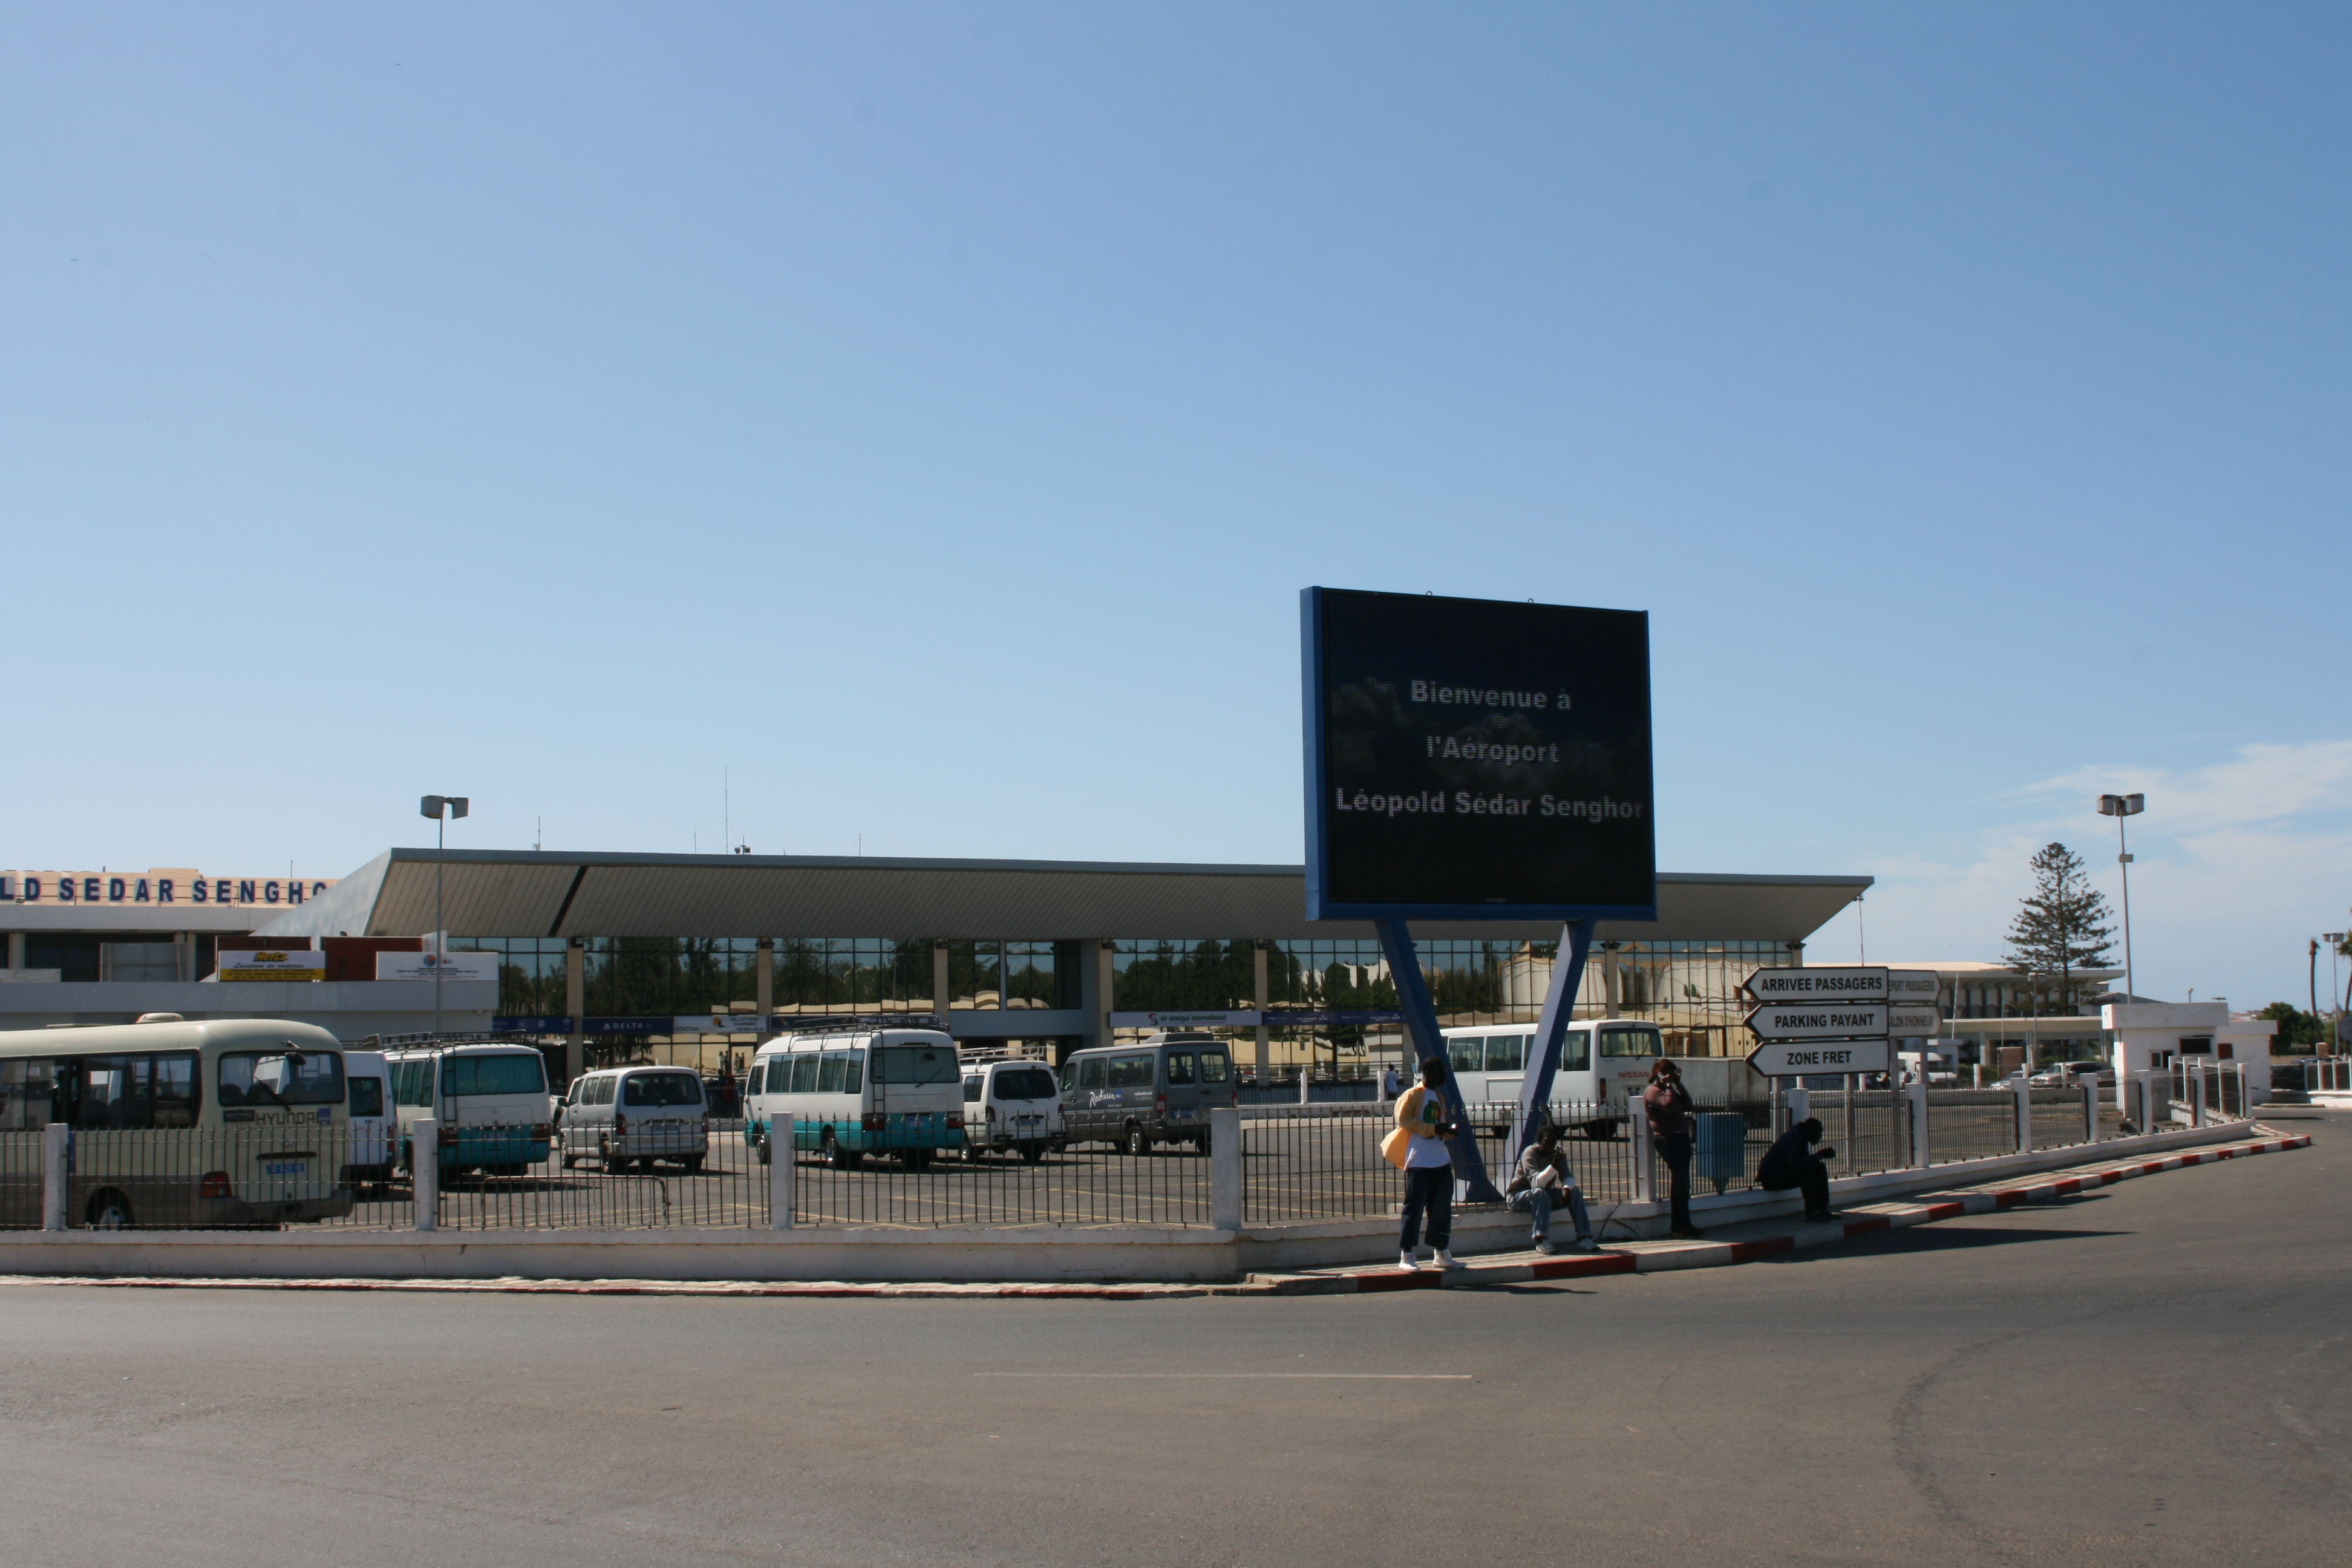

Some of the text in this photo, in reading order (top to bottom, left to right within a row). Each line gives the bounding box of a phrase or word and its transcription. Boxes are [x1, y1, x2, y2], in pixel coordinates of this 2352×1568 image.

[1411, 680, 1572, 710] Bienvenue à
[1426, 735, 1559, 766] l'Aéroport
[1336, 788, 1645, 823] Léopold Sédar Senghor
[59, 877, 174, 903] SEDAR
[253, 952, 289, 962] Hertz
[1761, 977, 1883, 991] ARRIVEE PASSAGERS
[1905, 979, 1935, 991] PASSAGERS
[1774, 1013, 1875, 1028] PARKING PAYANT
[1786, 1051, 1851, 1065] ZONE FRET
[1089, 1089, 1116, 1108] Radisson
